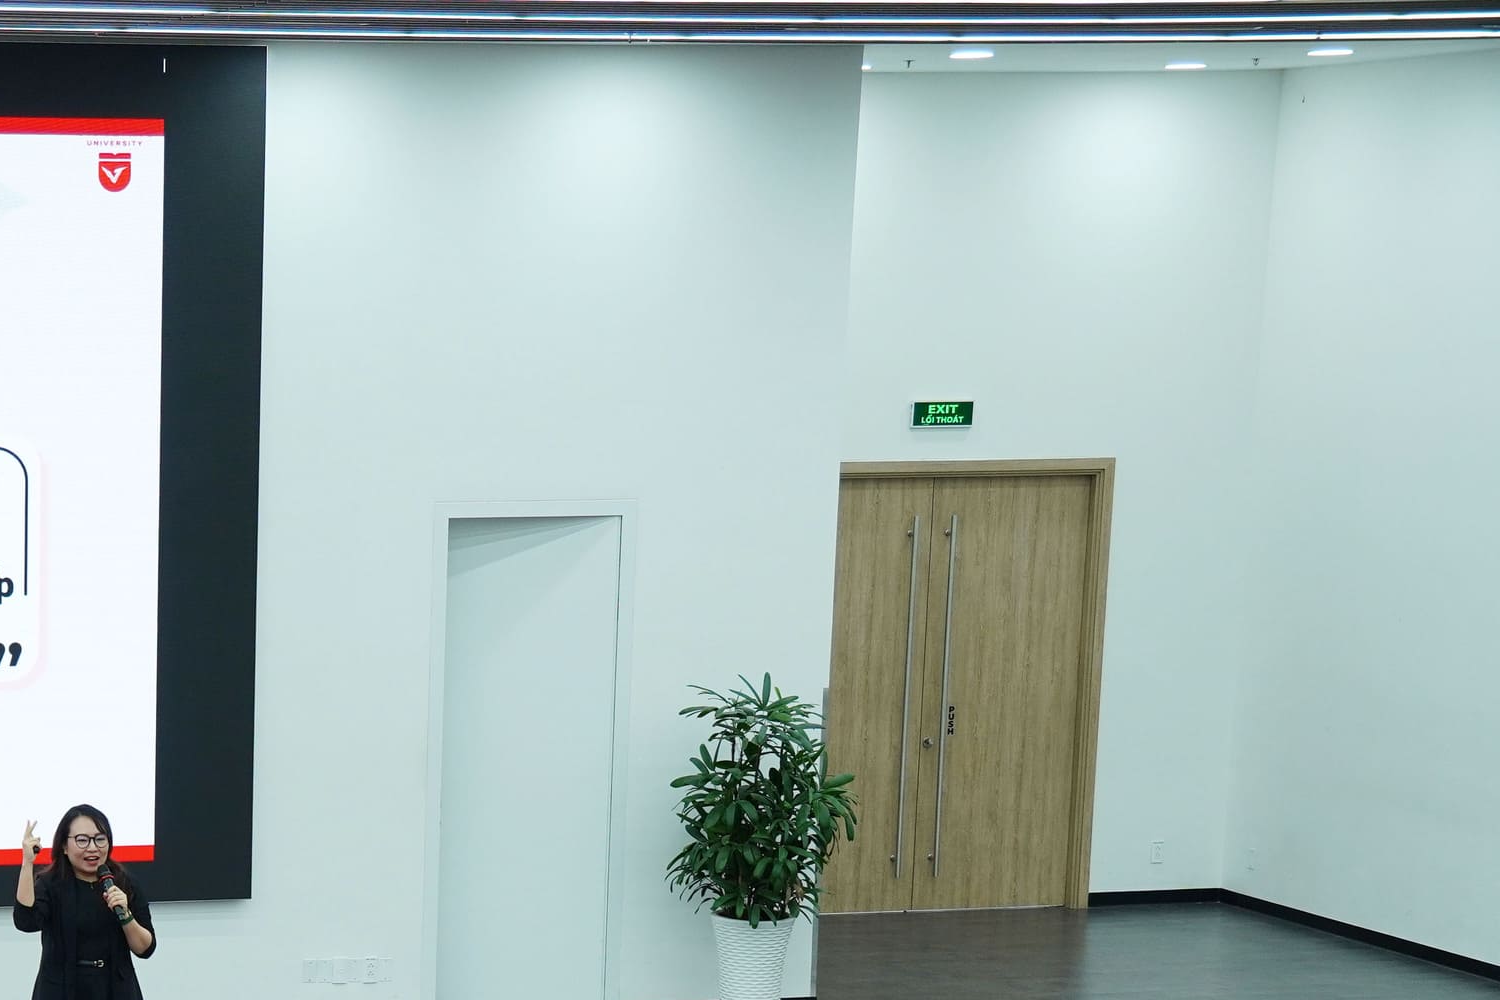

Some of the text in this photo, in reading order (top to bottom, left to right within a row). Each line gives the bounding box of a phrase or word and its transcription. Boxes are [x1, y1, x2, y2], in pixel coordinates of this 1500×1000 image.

[928, 404, 959, 414] EXIT
[921, 414, 964, 424] LỐI THOÁT
